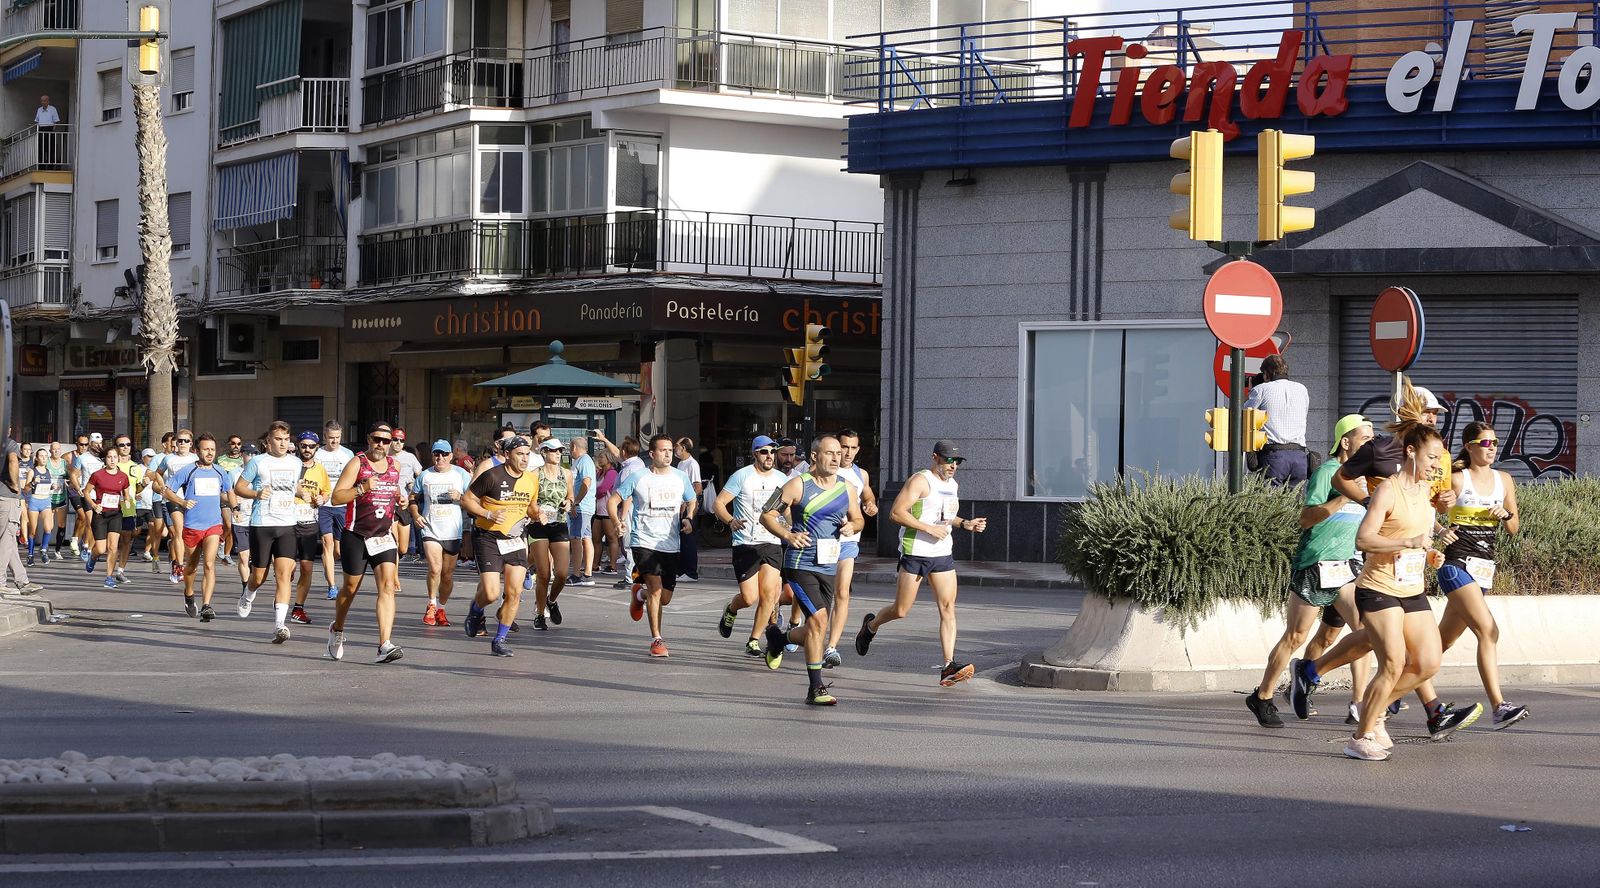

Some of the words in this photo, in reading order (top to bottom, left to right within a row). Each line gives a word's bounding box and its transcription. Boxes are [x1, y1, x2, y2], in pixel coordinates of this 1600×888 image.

[1068, 30, 1353, 142] Tienda
[1385, 19, 1473, 113] el
[434, 300, 542, 336] christian
[580, 302, 643, 321] Panadería
[666, 300, 759, 322] Pastelería
[277, 500, 292, 508] 307
[373, 536, 393, 545] 192
[1472, 564, 1492, 578] 279
